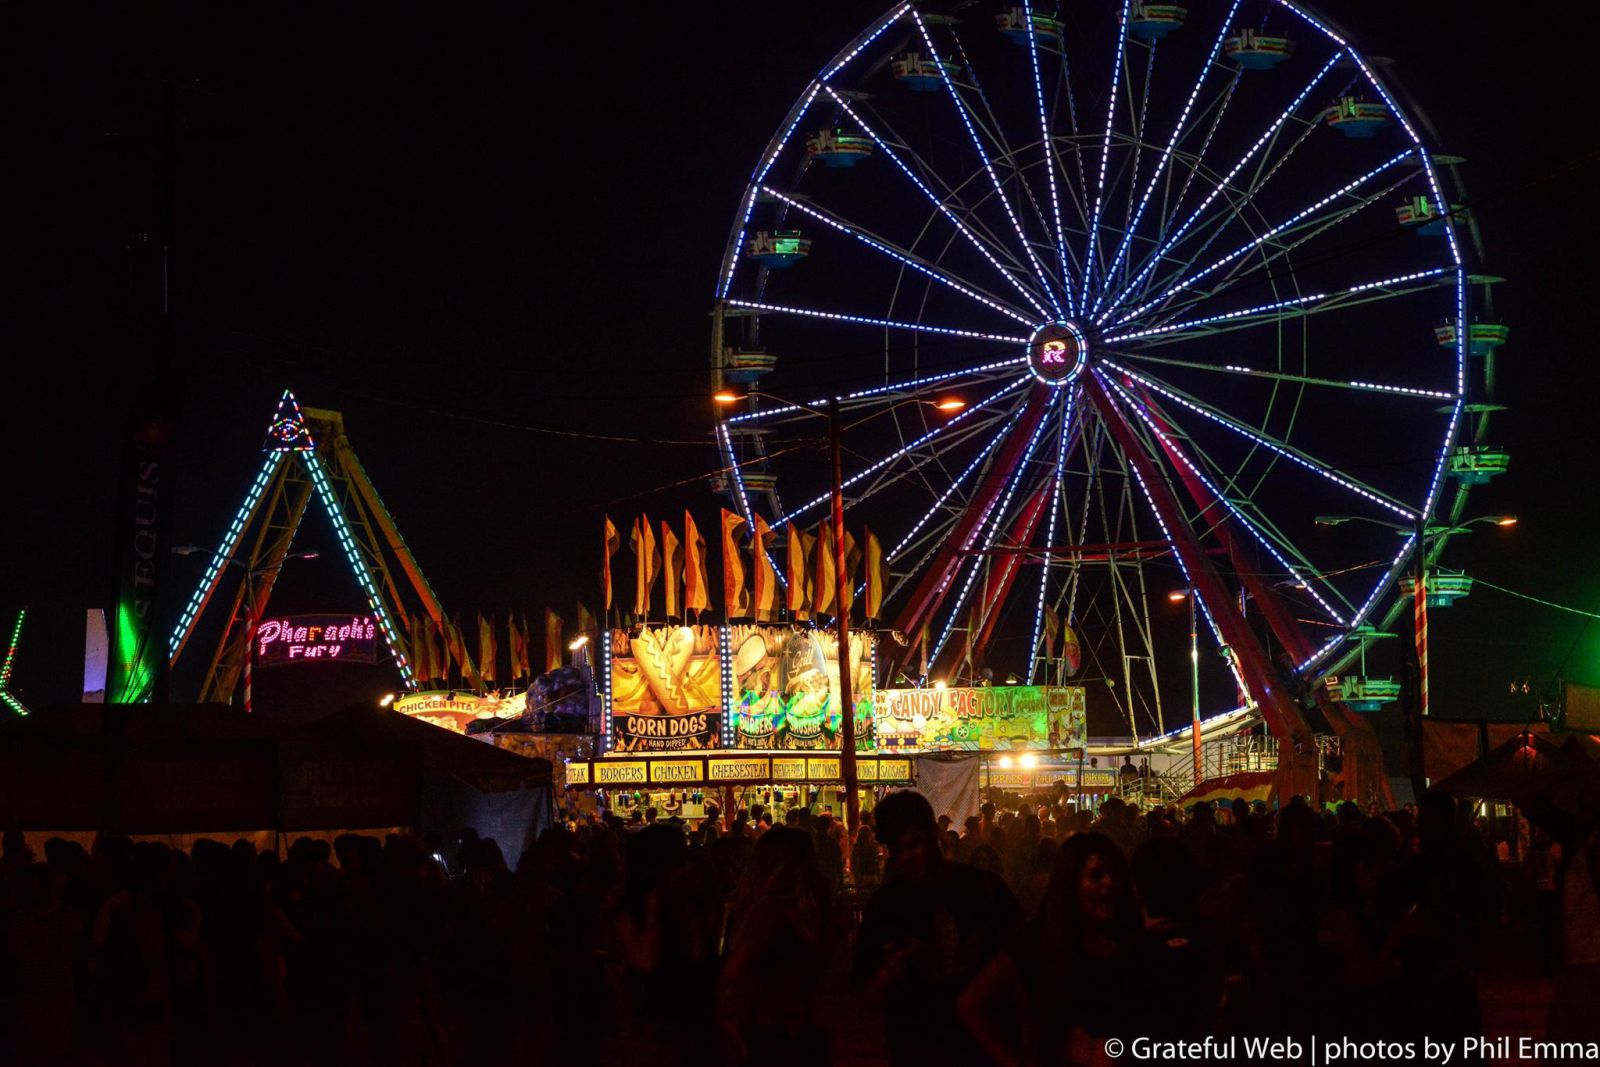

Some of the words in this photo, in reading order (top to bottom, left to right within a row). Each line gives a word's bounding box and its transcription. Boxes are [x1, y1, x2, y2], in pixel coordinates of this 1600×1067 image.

[134, 461, 159, 588] EQUIS
[257, 617, 375, 656] Pharaoh's
[289, 644, 341, 658] Fury
[400, 701, 446, 714] CHICKEN
[450, 701, 472, 711] PITA
[891, 690, 942, 719] CANDY
[949, 689, 1015, 718] FACTORY
[627, 716, 667, 736] CORN
[670, 713, 707, 736] DOGS
[654, 765, 697, 780] CHICKEN
[712, 763, 767, 778] CHEESESTEAK
